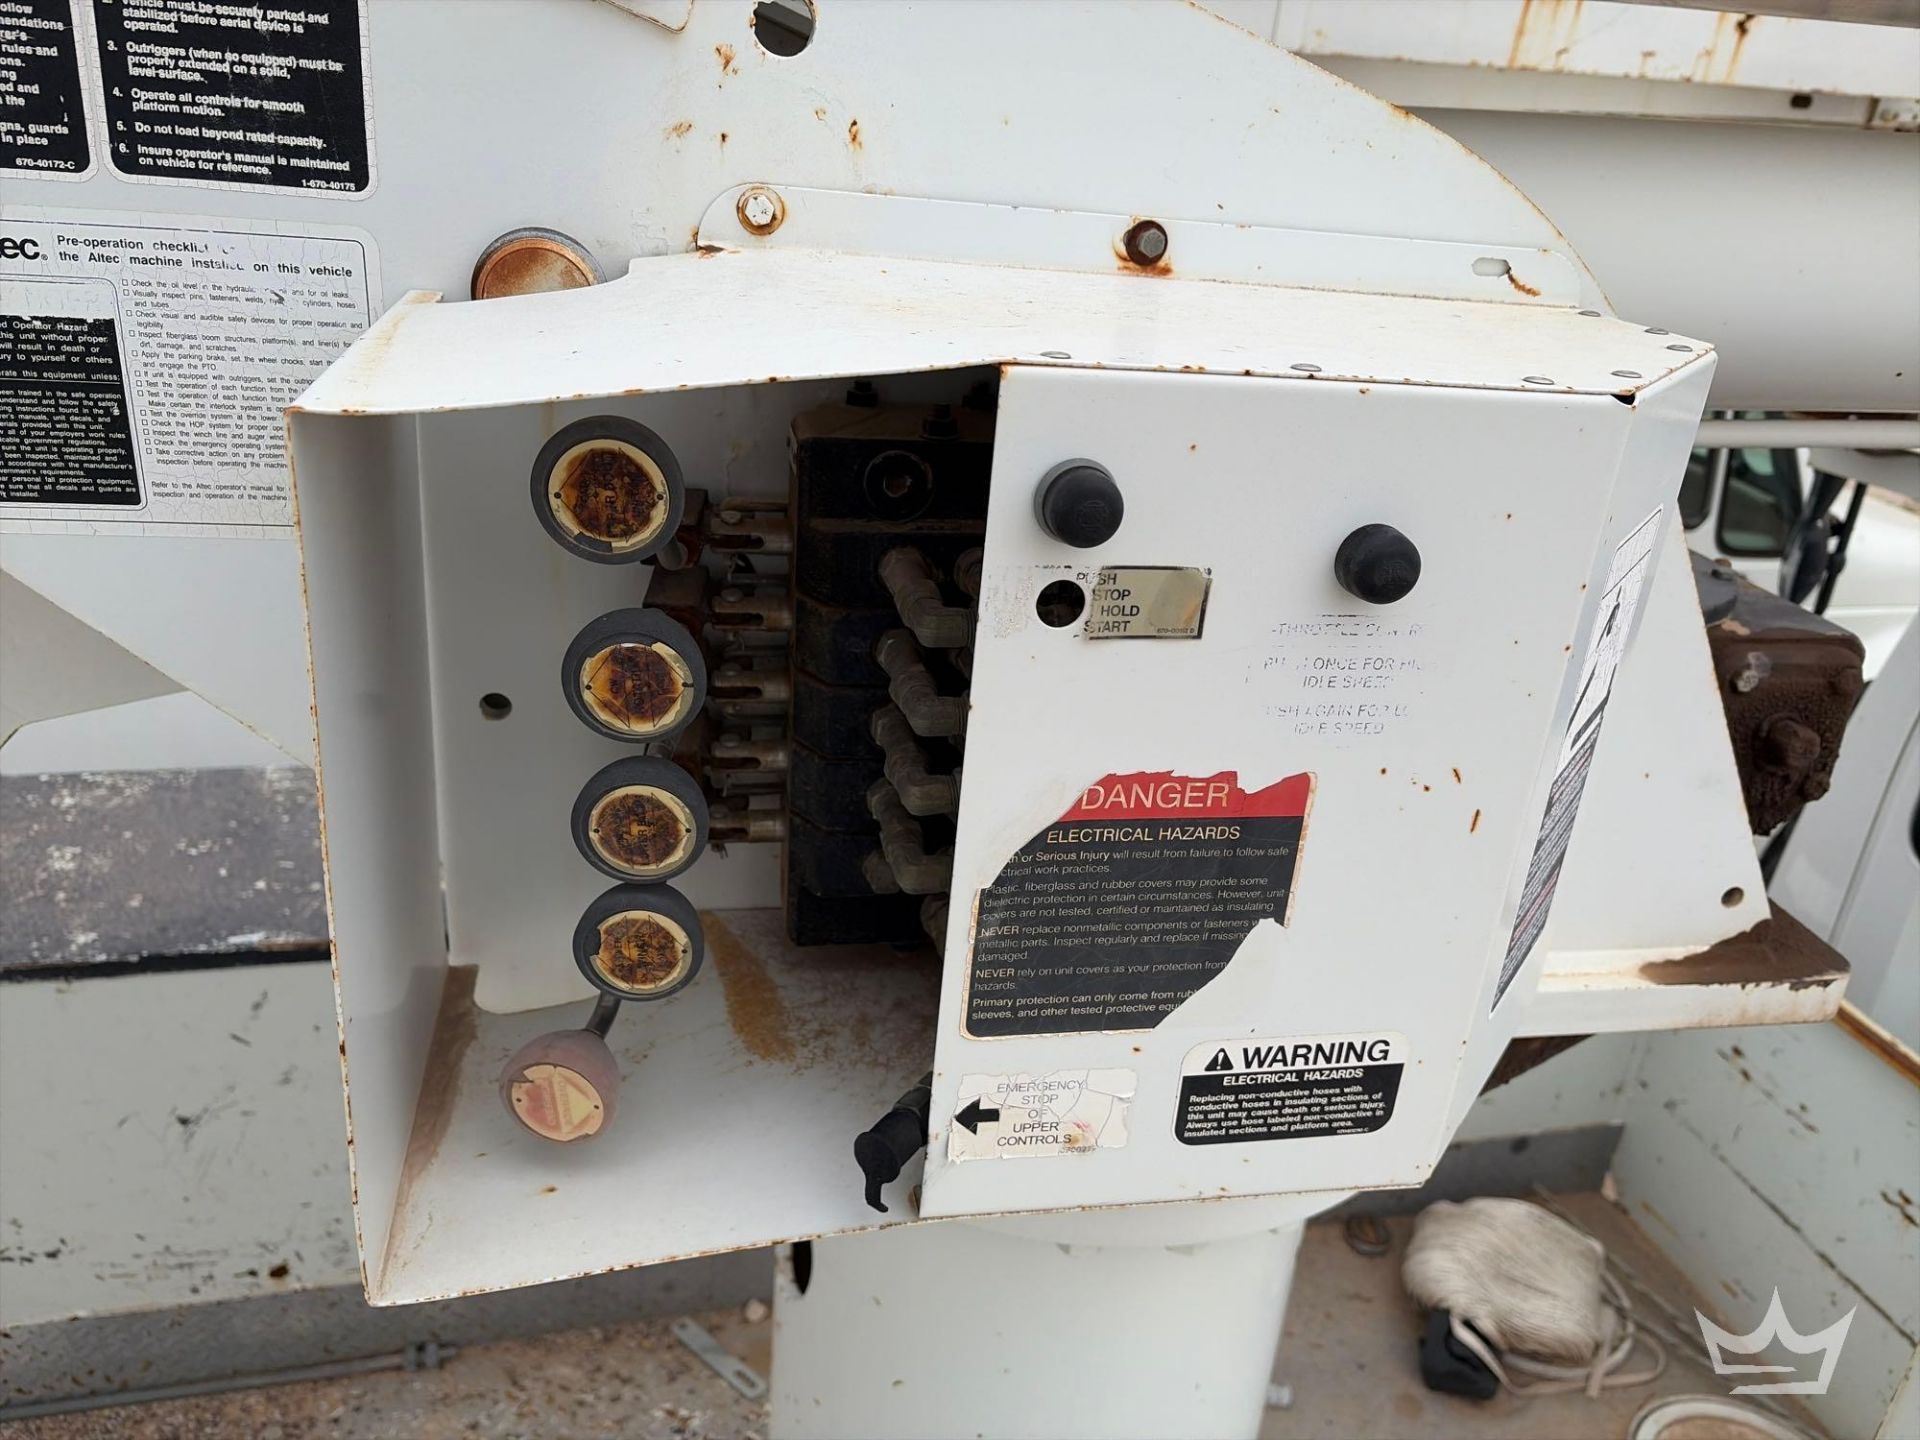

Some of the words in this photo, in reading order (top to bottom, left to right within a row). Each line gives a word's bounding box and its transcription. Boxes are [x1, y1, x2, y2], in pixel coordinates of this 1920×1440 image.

[167, 1, 196, 11] must
[199, 2, 213, 12] be
[216, 6, 263, 20] securely
[267, 10, 305, 21] parked
[308, 13, 329, 23] and
[123, 7, 178, 21] stabilized
[181, 12, 217, 25] before
[220, 17, 250, 28] aerial
[254, 19, 290, 31] device
[293, 23, 304, 33] is
[124, 21, 178, 32] operated.
[2, 44, 32, 54] rules
[36, 46, 58, 56] and
[107, 41, 117, 50] 3.
[126, 42, 186, 58] Outriggers
[189, 48, 222, 60] (when
[225, 53, 239, 61] so
[241, 54, 296, 70] equipped)
[299, 59, 327, 69] must
[329, 60, 342, 71] be
[127, 54, 175, 69] properly
[178, 58, 230, 71] extended
[233, 64, 247, 72] on
[260, 66, 290, 80] solid,
[129, 66, 156, 76] level
[158, 69, 204, 80] surface.
[17, 84, 39, 94] and
[6, 95, 25, 106] the
[113, 87, 123, 97] 4.
[131, 88, 176, 102] Operate
[179, 92, 192, 102] all
[195, 95, 241, 106] controls
[243, 97, 259, 108] for
[262, 101, 305, 112] smooth
[132, 100, 179, 112] platform
[183, 104, 225, 115] motion.
[28, 124, 69, 134] guards
[117, 121, 126, 130] 5.
[135, 122, 151, 132] Do
[154, 124, 172, 134] not
[175, 125, 199, 136] load
[202, 127, 243, 141] beyond
[246, 132, 274, 142] rated
[278, 135, 327, 149] capacity.
[1, 132, 13, 143] in
[16, 134, 48, 145] place
[16, 158, 75, 169] 670-40172-C
[119, 143, 129, 153] 6.
[138, 143, 172, 156] Insure
[176, 149, 231, 160] operator's
[234, 154, 274, 164] manual
[277, 155, 287, 165] is
[290, 157, 350, 170] maintained
[156, 157, 195, 168] vehicle
[198, 160, 214, 170] for
[217, 162, 271, 174] reference.
[57, 235, 144, 250] Pre-operation
[60, 251, 79, 261] the
[89, 252, 120, 264] Altec
[130, 256, 182, 267] machine
[254, 263, 269, 272] on
[278, 263, 300, 274] this
[309, 266, 352, 277] vehicle
[57, 323, 88, 331] Hazard
[31, 354, 65, 362] yourself
[1077, 573, 1117, 585] PUSH
[1093, 589, 1131, 600] STOP
[1101, 605, 1139, 616] HOLD
[1084, 621, 1130, 633] START
[1313, 657, 1357, 670] ONCE
[1363, 658, 1394, 670] FOR
[1081, 782, 1229, 809] DANGER
[1047, 828, 1153, 843] ELECTRICAL
[1159, 826, 1240, 840] HAZARDS
[1036, 851, 1076, 861] Serious
[1080, 851, 1109, 862] Injury
[1113, 850, 1129, 859] will
[1132, 850, 1160, 859] result
[1164, 850, 1187, 858] from
[1190, 849, 1220, 857] failure
[1224, 849, 1233, 857] to
[1236, 847, 1264, 856] follow
[1267, 846, 1289, 856] safe
[976, 969, 1015, 978] NEVER
[1018, 969, 1036, 978] rely
[1055, 967, 1073, 975] unit
[1128, 966, 1148, 974] your
[1153, 963, 1201, 974] protection
[973, 999, 1013, 1008] Primary
[1016, 995, 1072, 1006] protection
[1243, 1040, 1390, 1069] WARNING
[1223, 1072, 1299, 1086] ELECTRICAL
[1304, 1068, 1364, 1080] HAZARDS
[997, 1080, 1084, 1093] EMERGENCY
[1021, 1094, 1058, 1104] STOP
[1190, 1094, 1234, 1103] Replacing
[1238, 1089, 1309, 1100] non-conductive
[1188, 1102, 1238, 1111] conductive
[1285, 1097, 1327, 1106] insulating
[1324, 1103, 1356, 1111] serious
[1360, 1102, 1385, 1110] injury.
[1028, 1109, 1048, 1119] OF
[1186, 1121, 1217, 1129] Always
[1267, 1116, 1300, 1124] labeled
[1303, 1110, 1372, 1120] non-conductive
[1013, 1121, 1059, 1133] UPPER
[1184, 1129, 1225, 1138] insulated
[1291, 1122, 1328, 1131] platform
[997, 1134, 1072, 1146] CONTROLS
